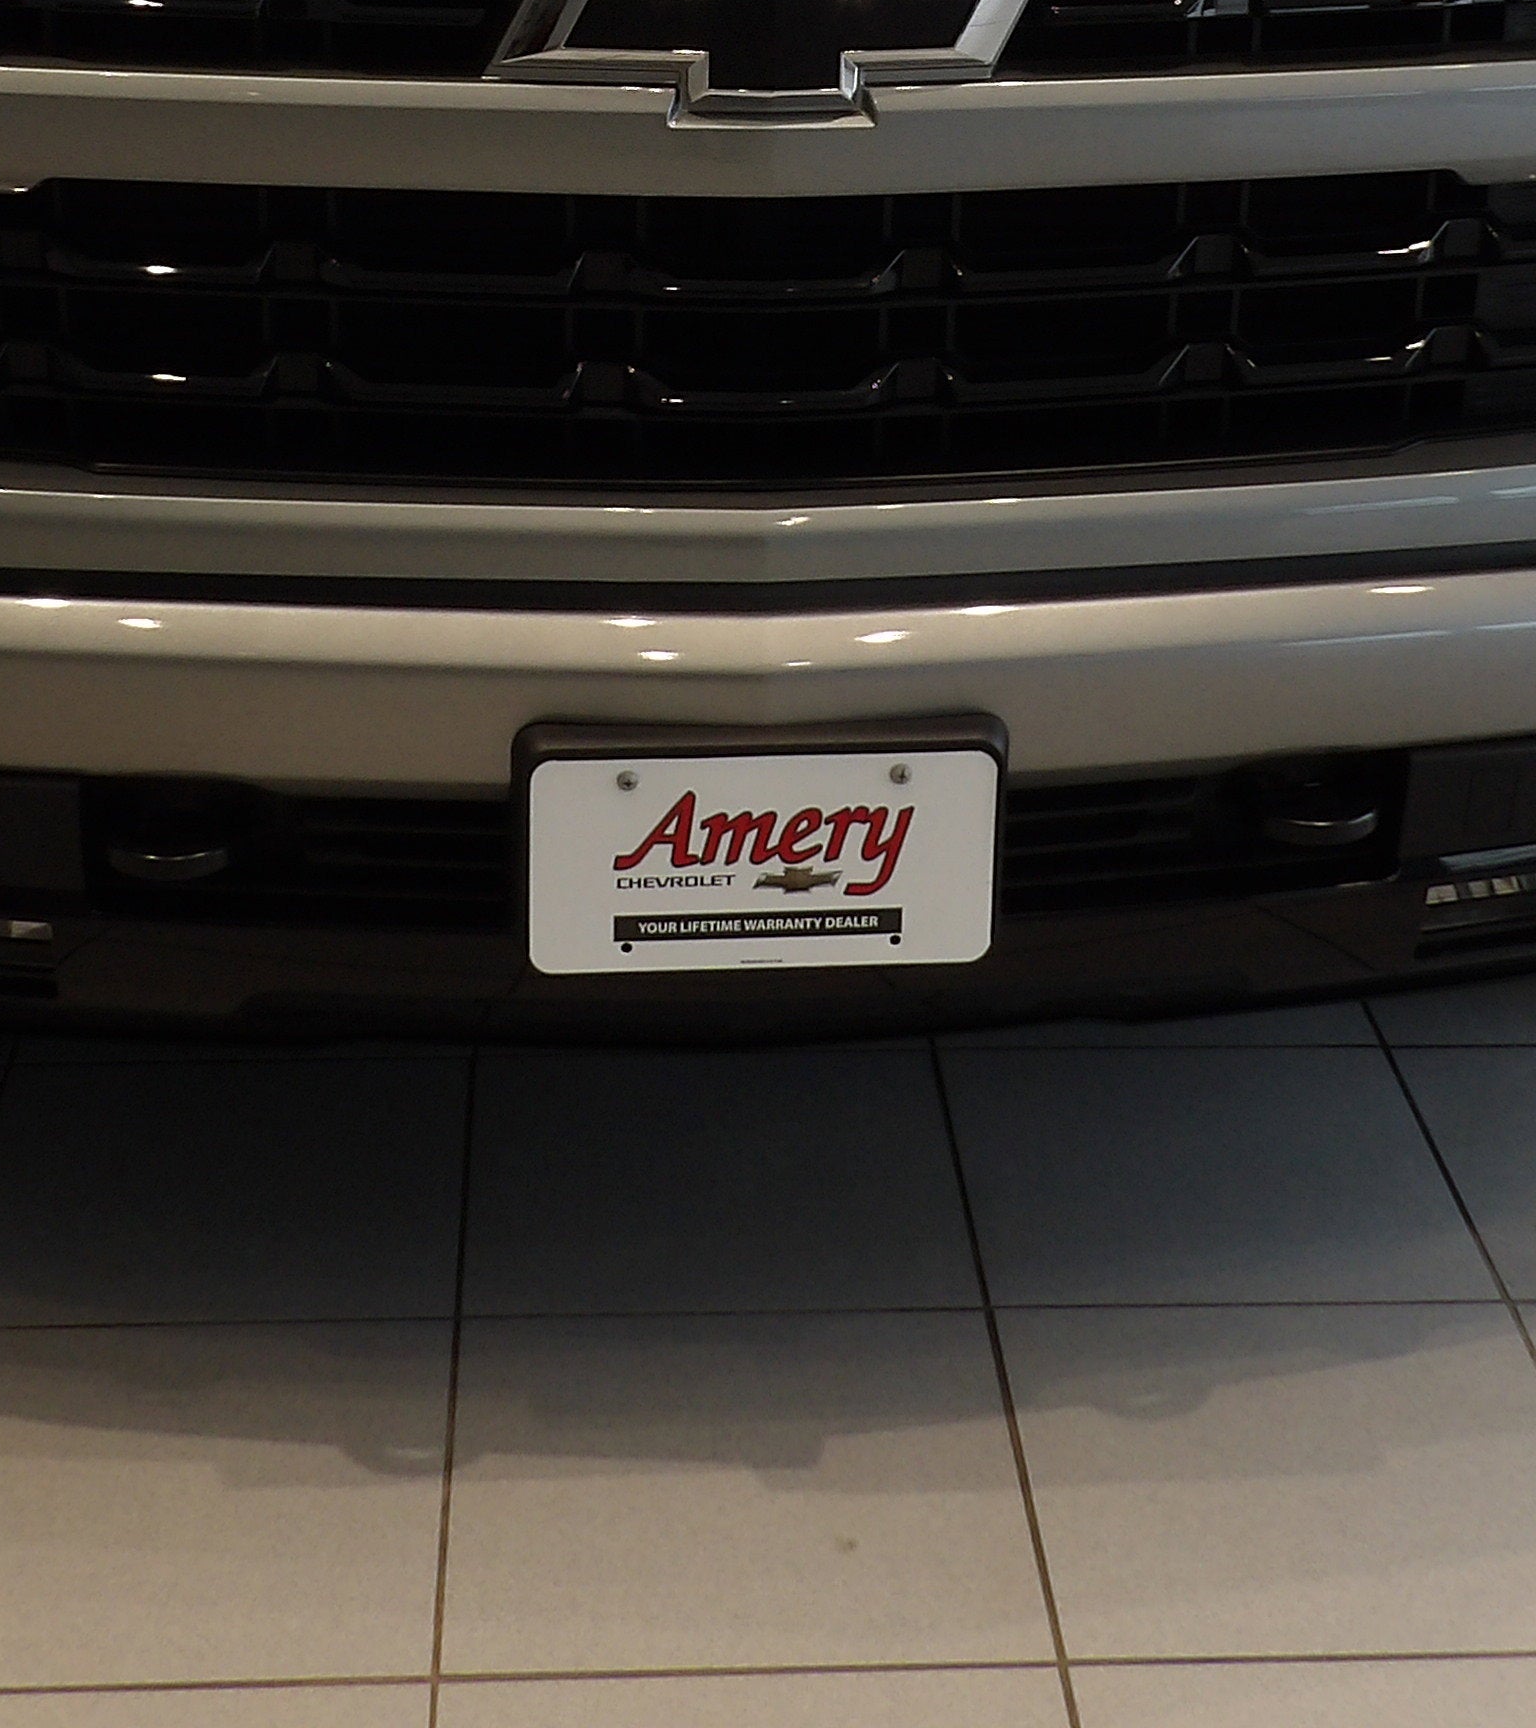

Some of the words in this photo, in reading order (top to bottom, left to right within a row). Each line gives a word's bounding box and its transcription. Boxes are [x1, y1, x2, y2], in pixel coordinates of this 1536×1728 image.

[613, 790, 915, 896] Amery
[616, 874, 736, 889] CHEVROLET
[638, 921, 677, 934] YOUR
[680, 920, 741, 933] LIFETIME
[744, 918, 822, 931] WARRANTY
[824, 916, 879, 929] DEALER
